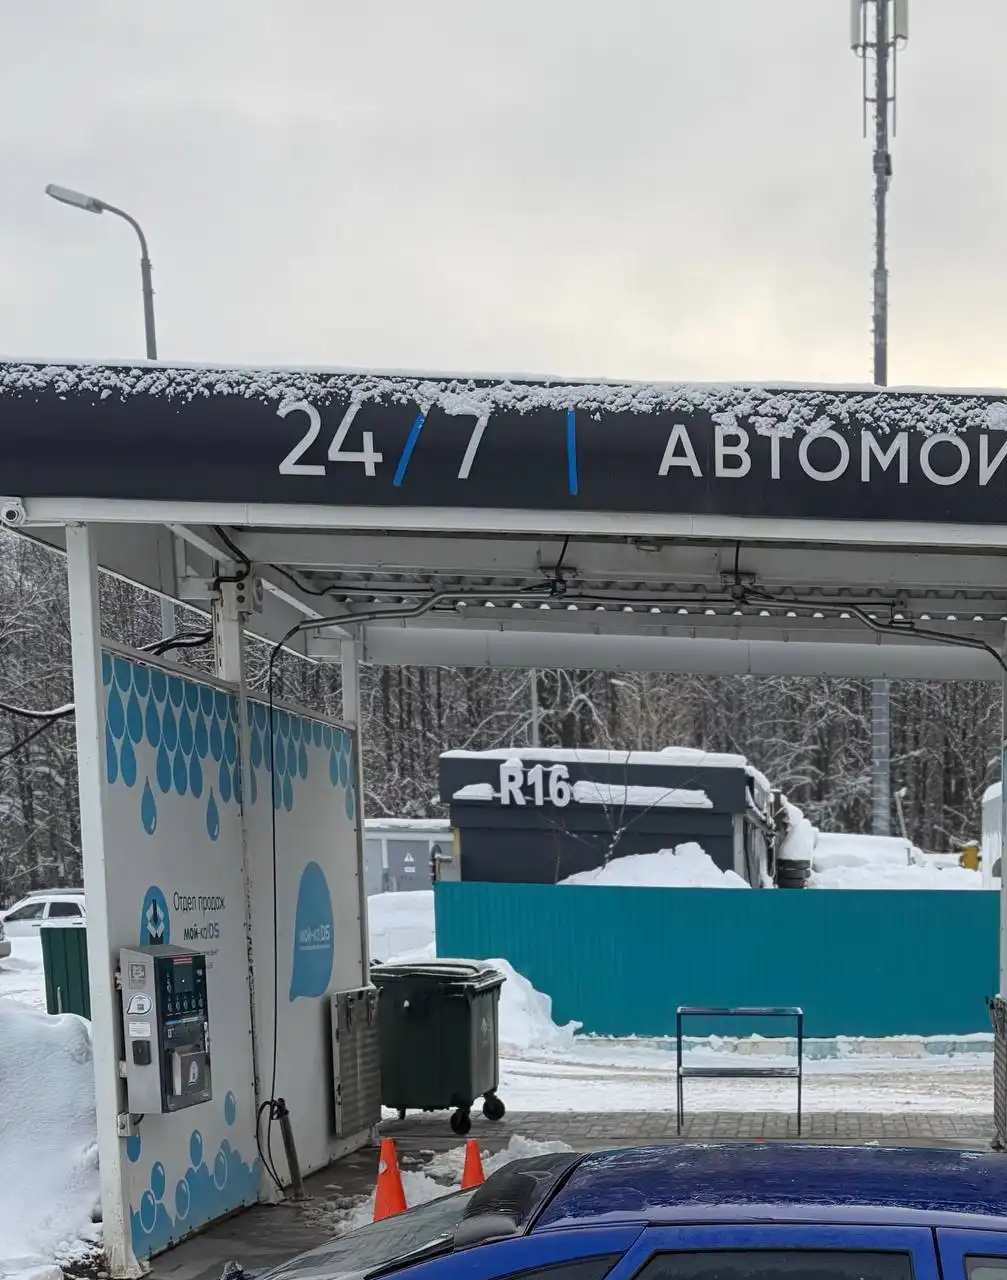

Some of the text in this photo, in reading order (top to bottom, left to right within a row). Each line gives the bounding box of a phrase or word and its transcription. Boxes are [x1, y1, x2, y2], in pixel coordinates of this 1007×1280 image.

[275, 399, 491, 487] 24/7
[499, 763, 571, 808] R16
[173, 891, 226, 917] Отдел продаж
